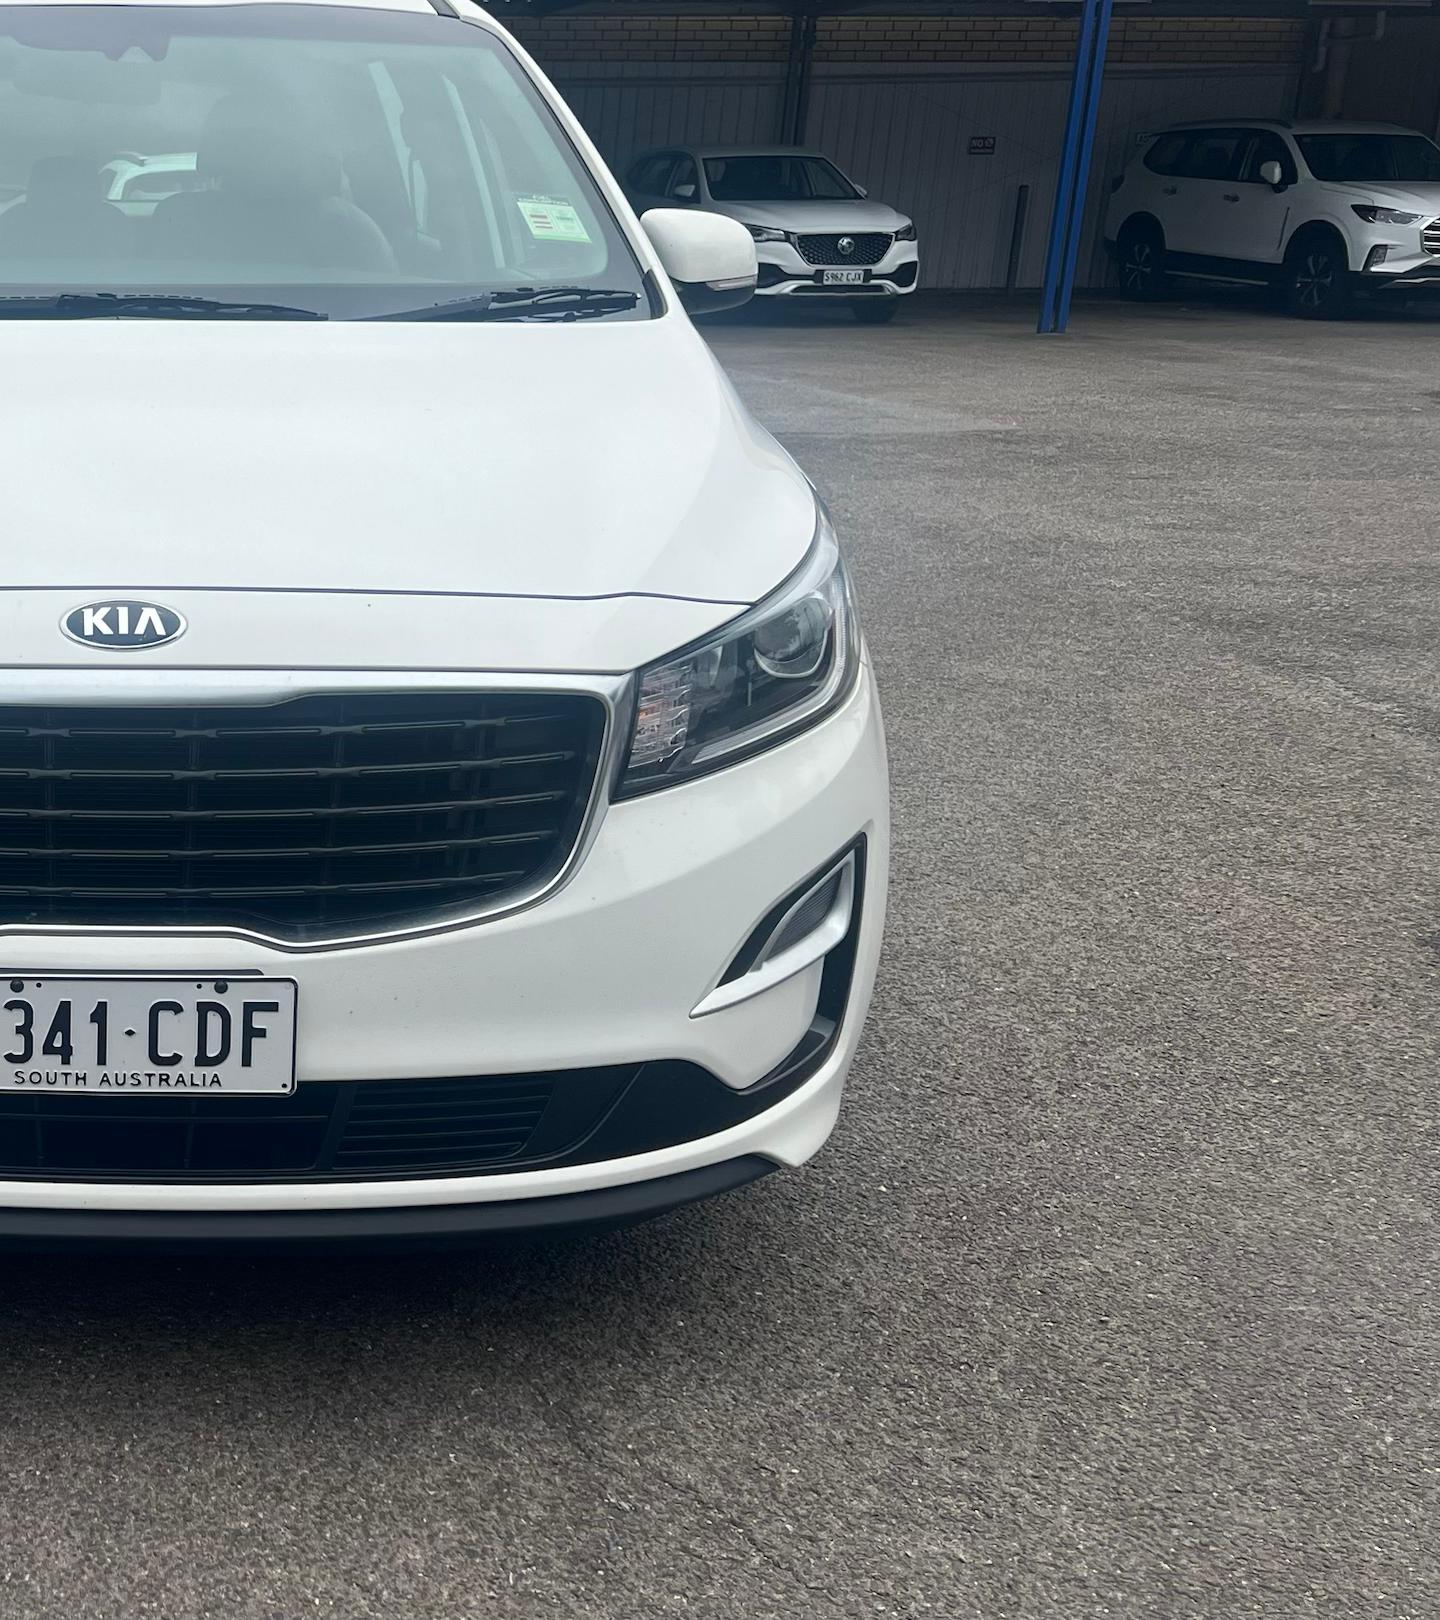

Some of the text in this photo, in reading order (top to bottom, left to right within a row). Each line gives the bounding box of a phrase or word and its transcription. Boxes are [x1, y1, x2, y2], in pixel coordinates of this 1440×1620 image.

[81, 606, 167, 636] KIA
[13, 1070, 223, 1088] SOUTH AUSTRALIA
